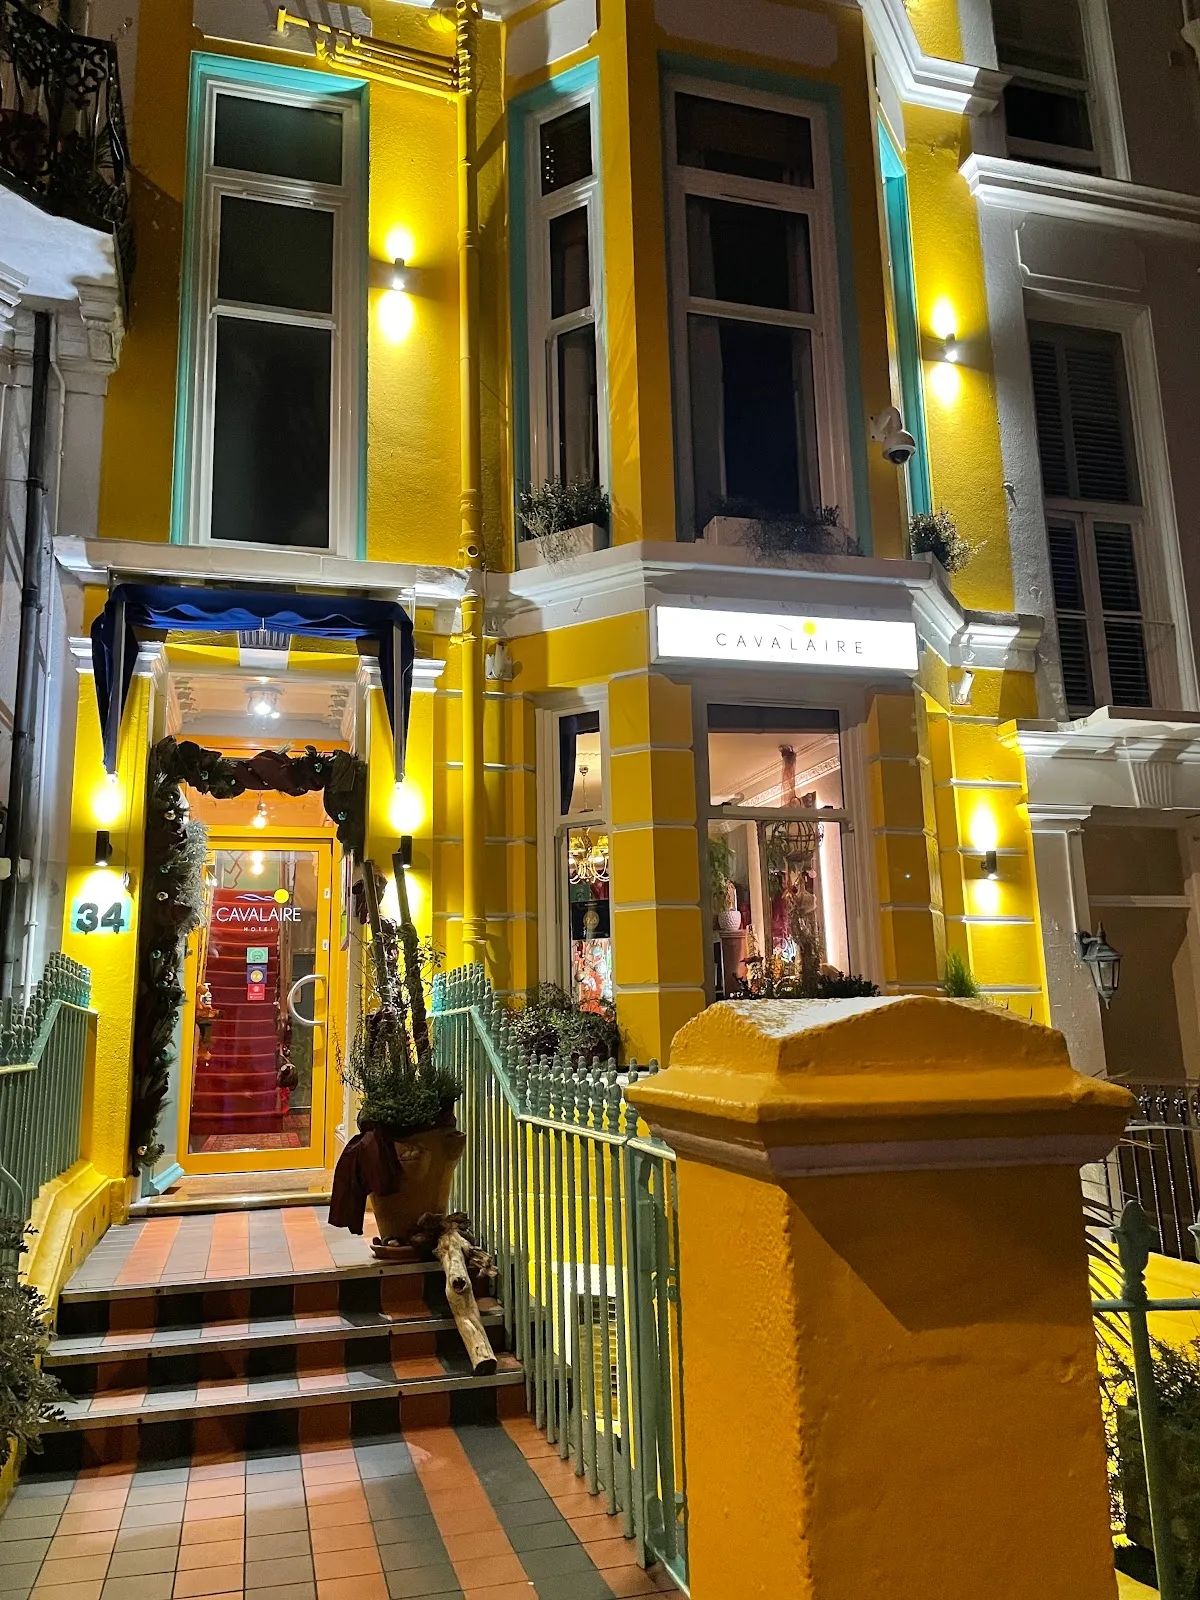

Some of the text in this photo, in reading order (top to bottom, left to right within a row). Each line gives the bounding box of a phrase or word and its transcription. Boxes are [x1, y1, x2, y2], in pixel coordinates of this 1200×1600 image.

[716, 633, 863, 654] CAVALAIRE
[76, 902, 125, 933] 34
[216, 907, 302, 922] CAVALAIRE
